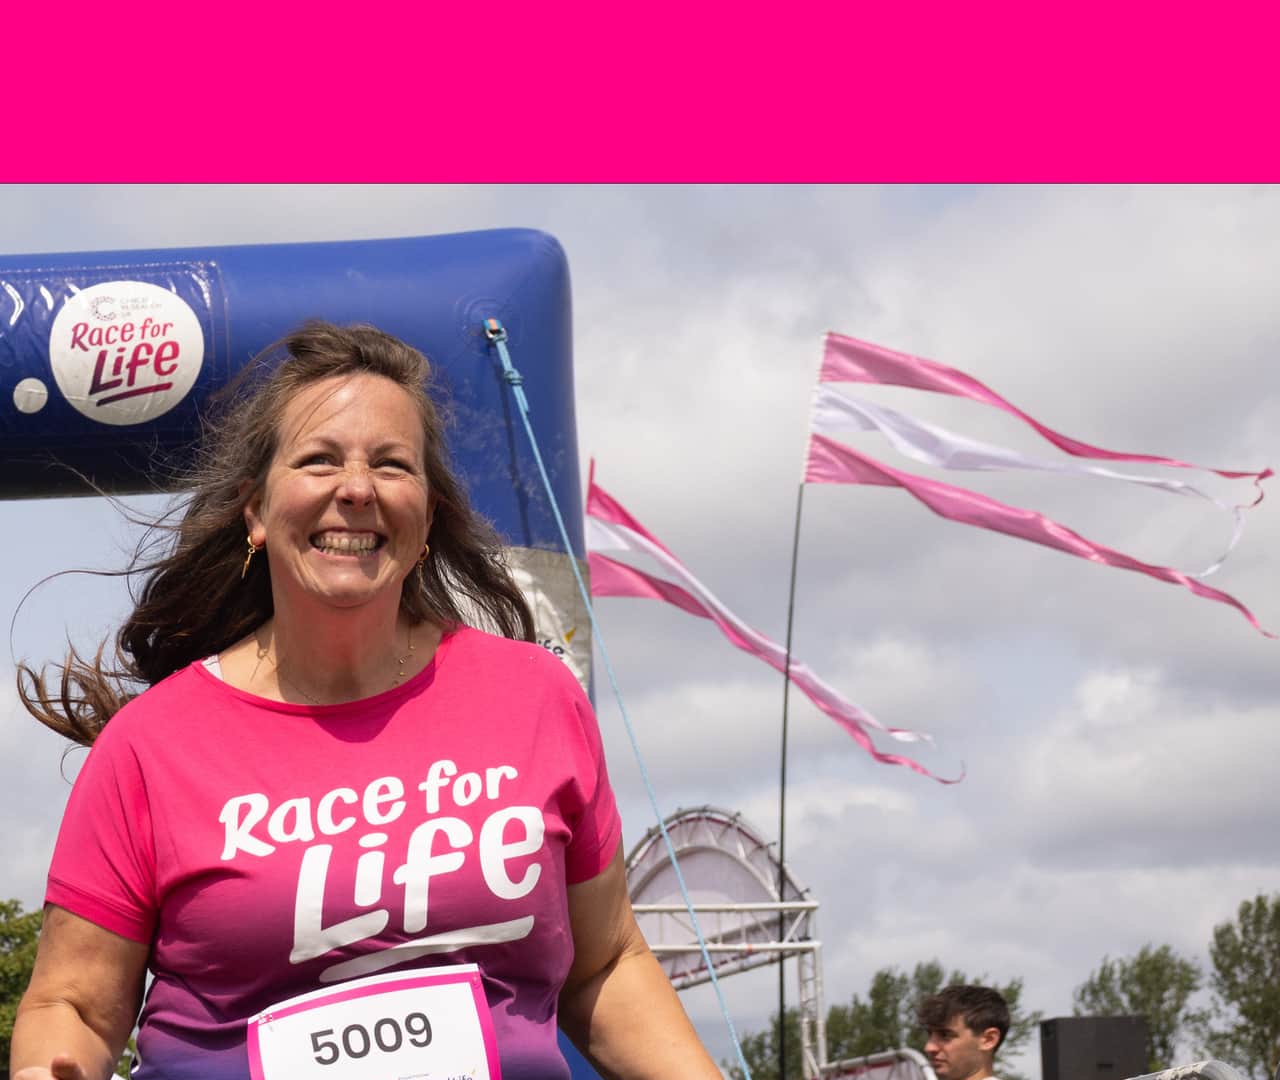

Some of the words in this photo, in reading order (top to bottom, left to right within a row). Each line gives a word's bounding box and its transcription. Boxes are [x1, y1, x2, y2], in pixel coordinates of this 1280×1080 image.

[71, 322, 134, 352] Race
[140, 317, 173, 339] for
[88, 341, 180, 395] Life
[218, 776, 406, 860] Race
[418, 759, 518, 814] for
[289, 806, 545, 964] Life
[311, 1012, 433, 1066] 5009
